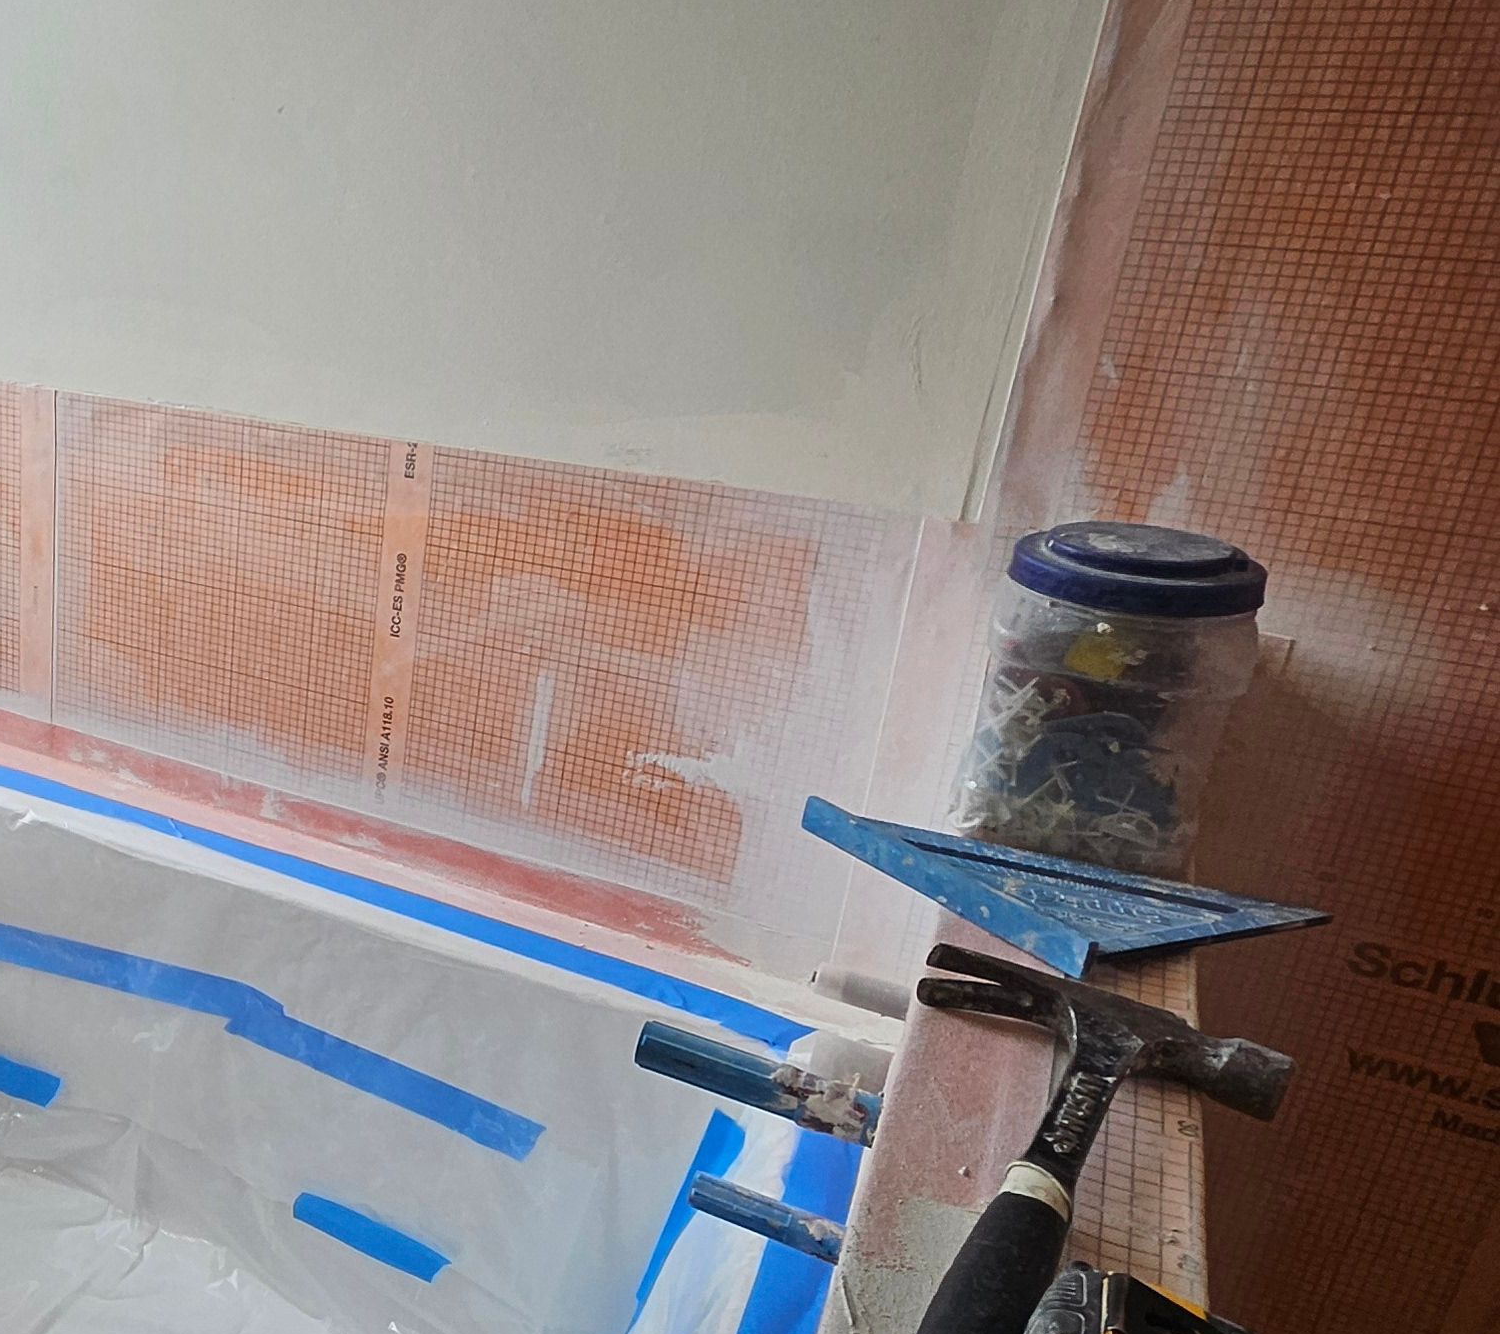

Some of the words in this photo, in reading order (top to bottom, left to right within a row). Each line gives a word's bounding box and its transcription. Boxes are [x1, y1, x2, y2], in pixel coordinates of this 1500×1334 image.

[390, 594, 404, 638] ICC-ES
[381, 696, 396, 740] A118.10
[379, 737, 390, 771] ANSI
